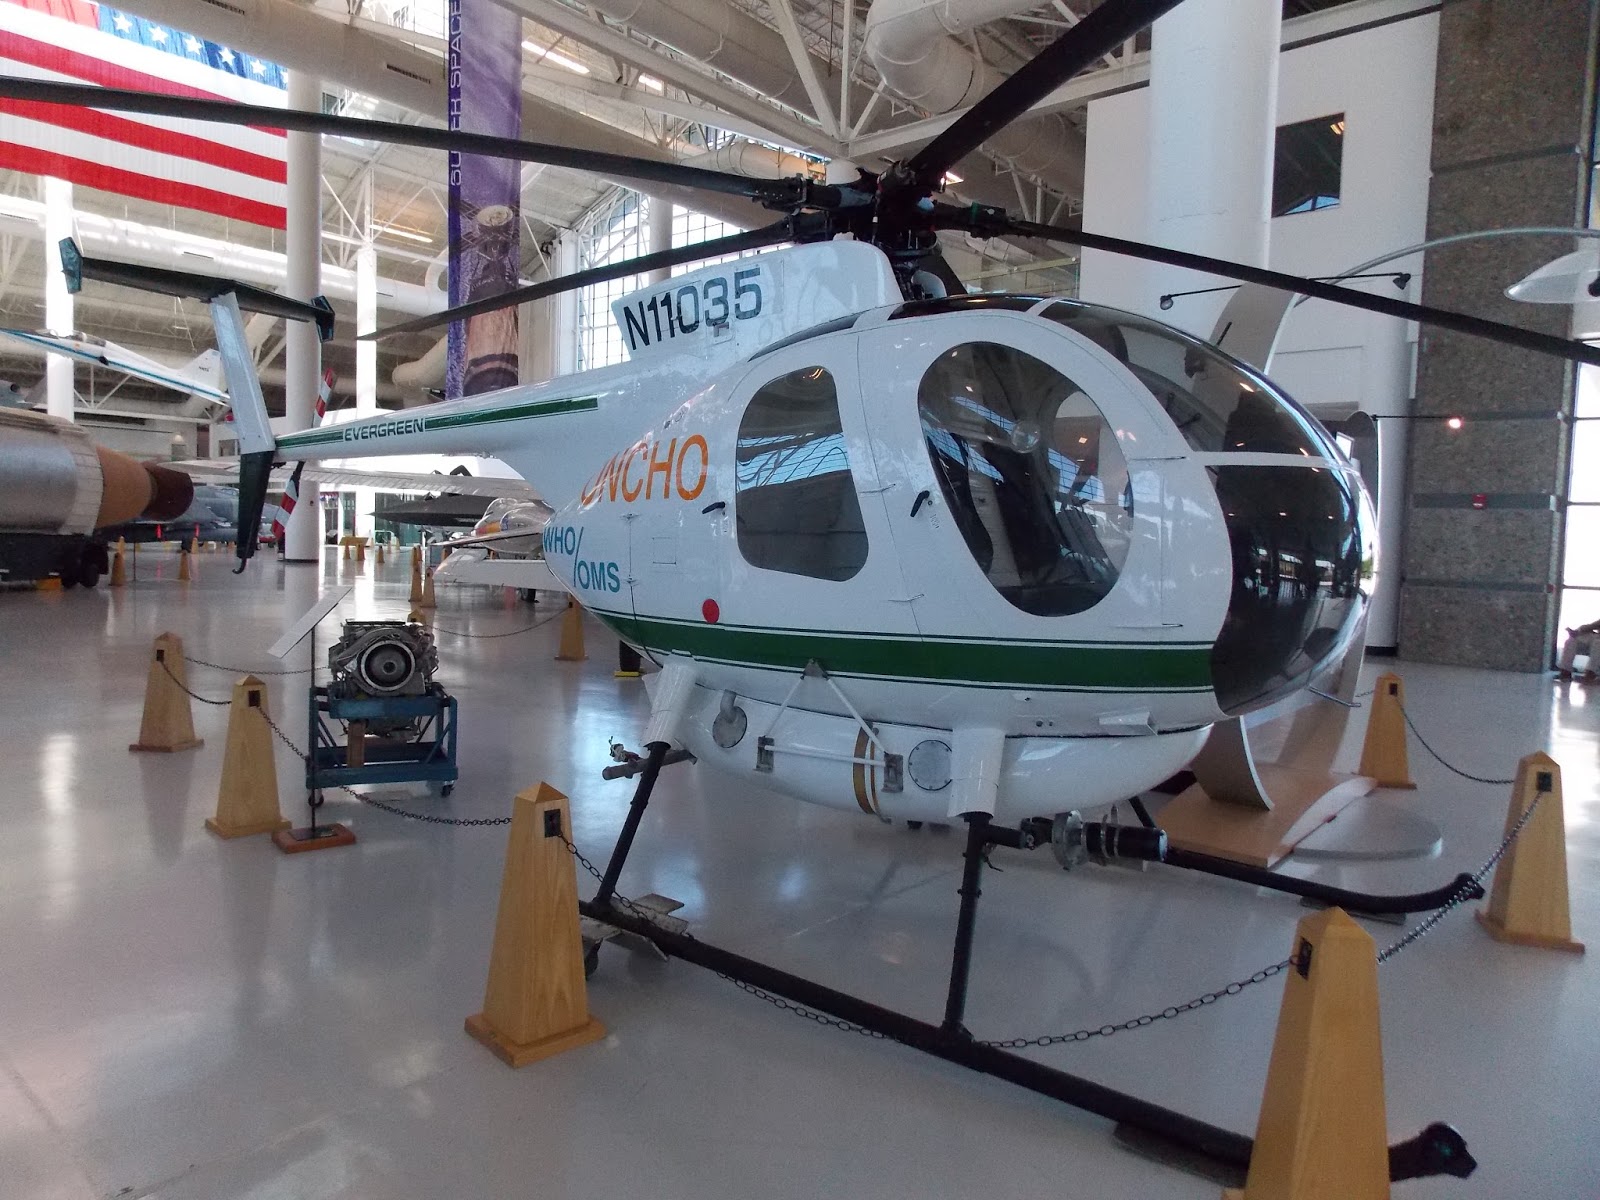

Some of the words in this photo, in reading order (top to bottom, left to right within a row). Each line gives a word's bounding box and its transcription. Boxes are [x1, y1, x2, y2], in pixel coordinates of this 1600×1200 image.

[451, 0, 462, 89] SPACE
[451, 98, 462, 186] SUER
[623, 267, 762, 351] N11035
[344, 418, 424, 441] EVERGREEN
[577, 560, 621, 593] OMS
